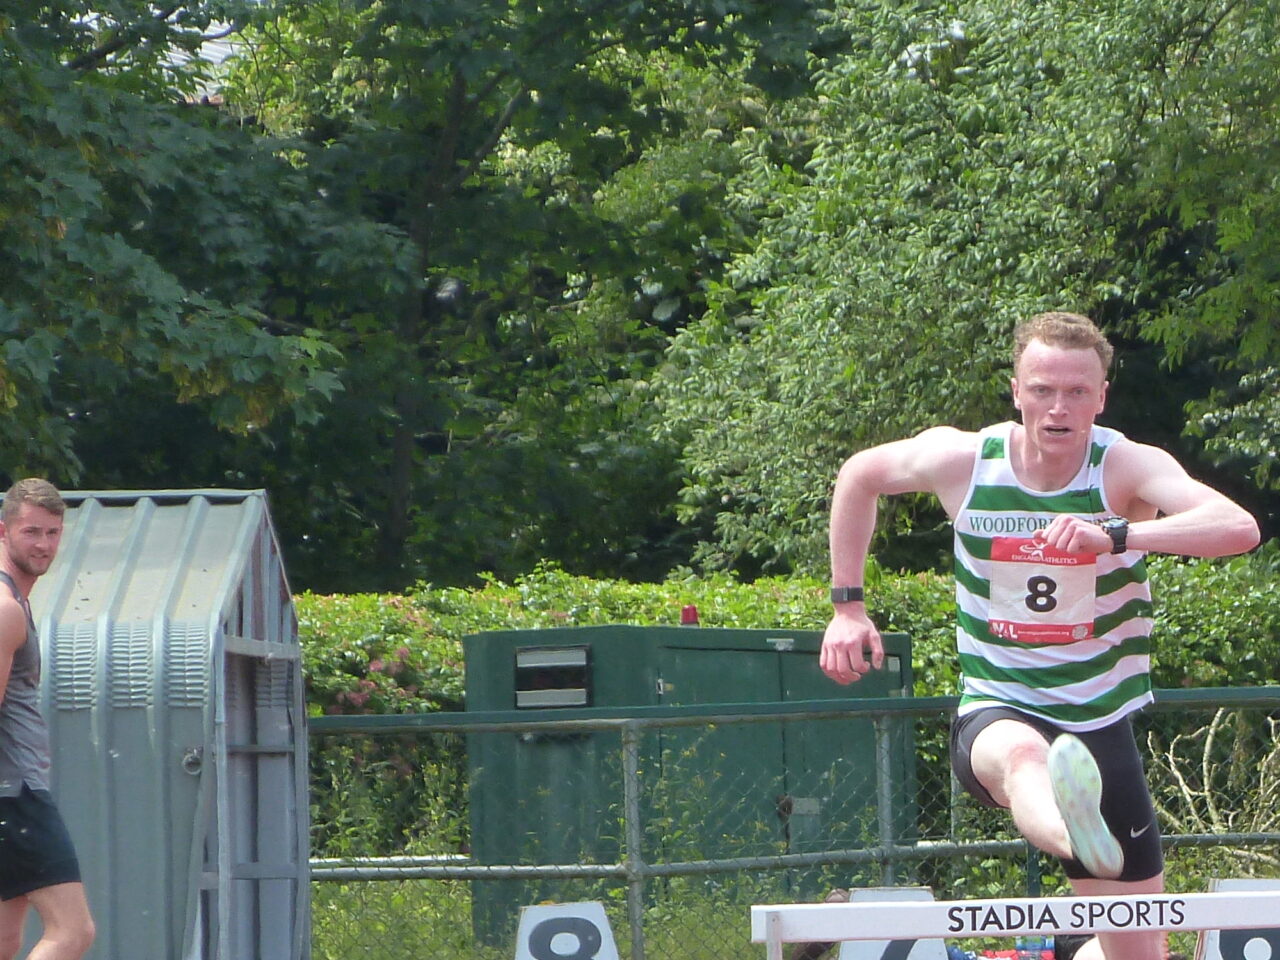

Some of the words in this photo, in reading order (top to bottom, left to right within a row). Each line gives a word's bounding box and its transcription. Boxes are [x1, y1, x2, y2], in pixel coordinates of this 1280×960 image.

[969, 516, 1054, 533] WOODFOR
[1025, 575, 1058, 613] 8
[948, 904, 1060, 932] STADIA
[1070, 900, 1186, 928] SPORTS
